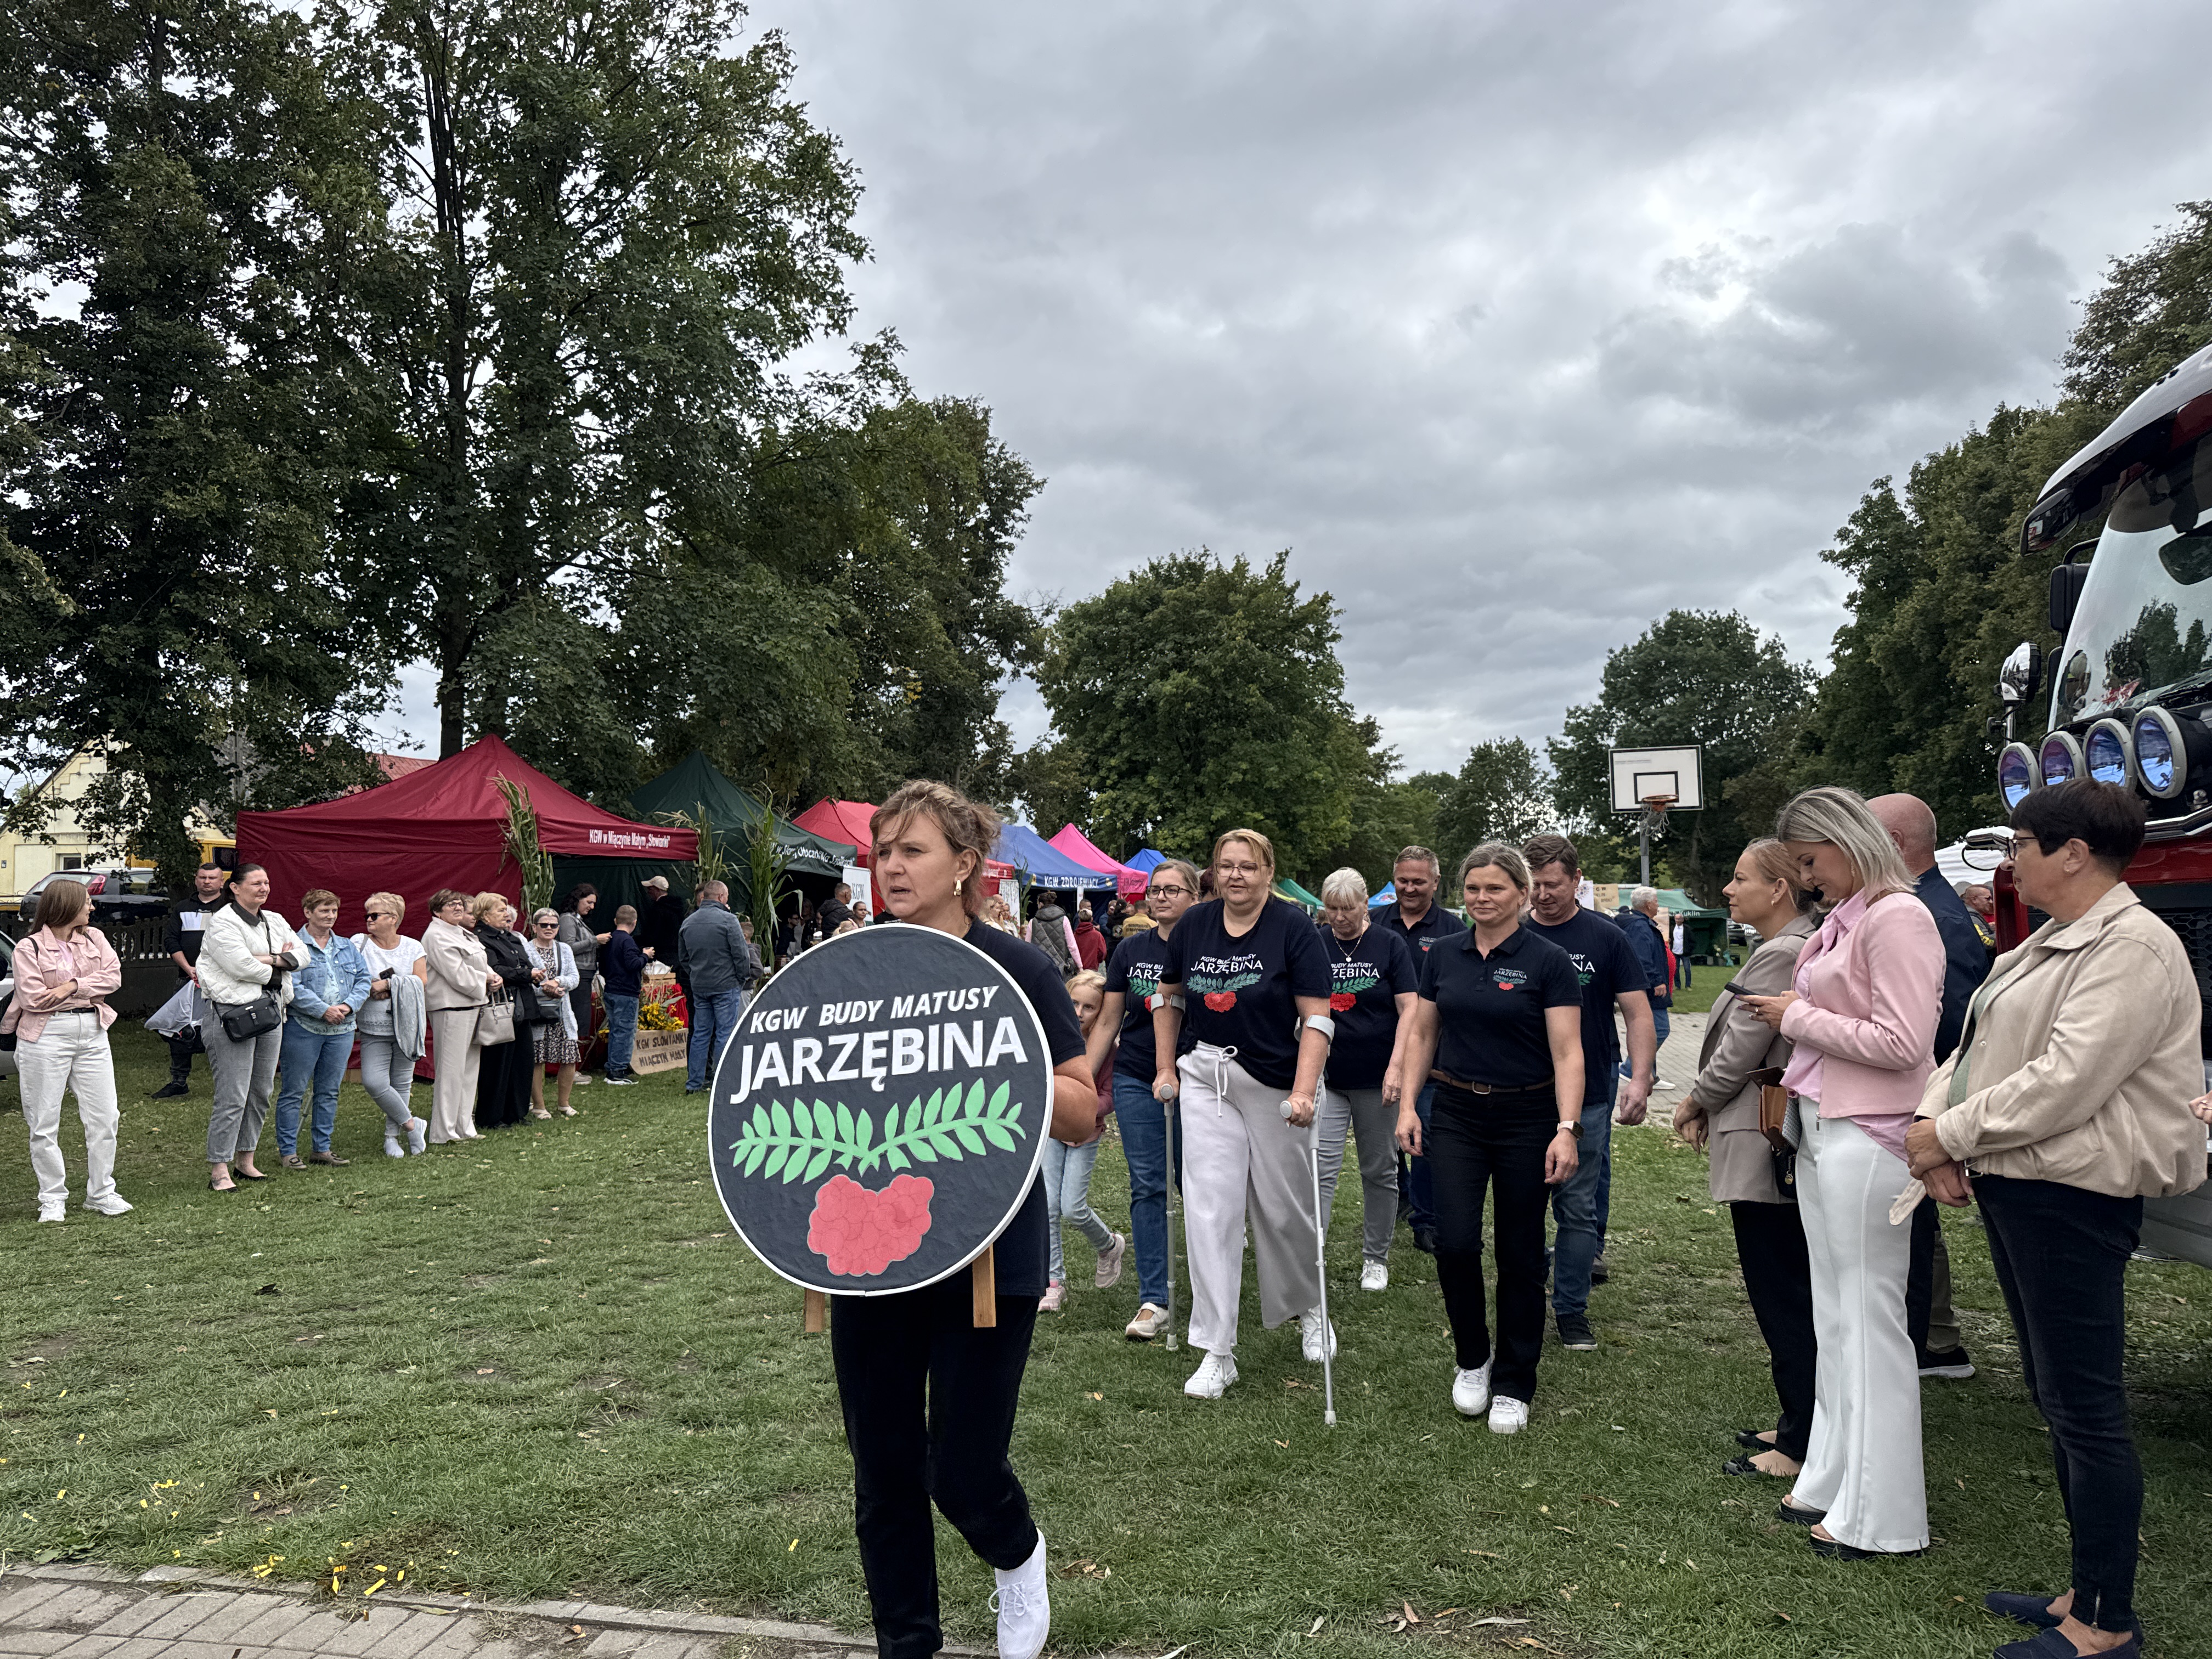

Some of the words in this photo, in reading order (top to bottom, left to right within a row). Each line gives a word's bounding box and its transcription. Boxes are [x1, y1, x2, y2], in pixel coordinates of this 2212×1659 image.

[589, 829, 603, 844] KGW
[603, 833, 608, 844] w
[1044, 876, 1059, 888] KGW
[851, 883, 865, 900] KGW
[1190, 960, 1263, 974] JARZĘBINA
[1332, 968, 1380, 980] ZĘBINA
[751, 1006, 809, 1034] KGW
[819, 1000, 883, 1026] BUDY
[890, 985, 999, 1019] MATUSY
[636, 1039, 649, 1049] KGW
[669, 1049, 686, 1061] MAŁY
[730, 1016, 1028, 1104] JARZĘBINA
